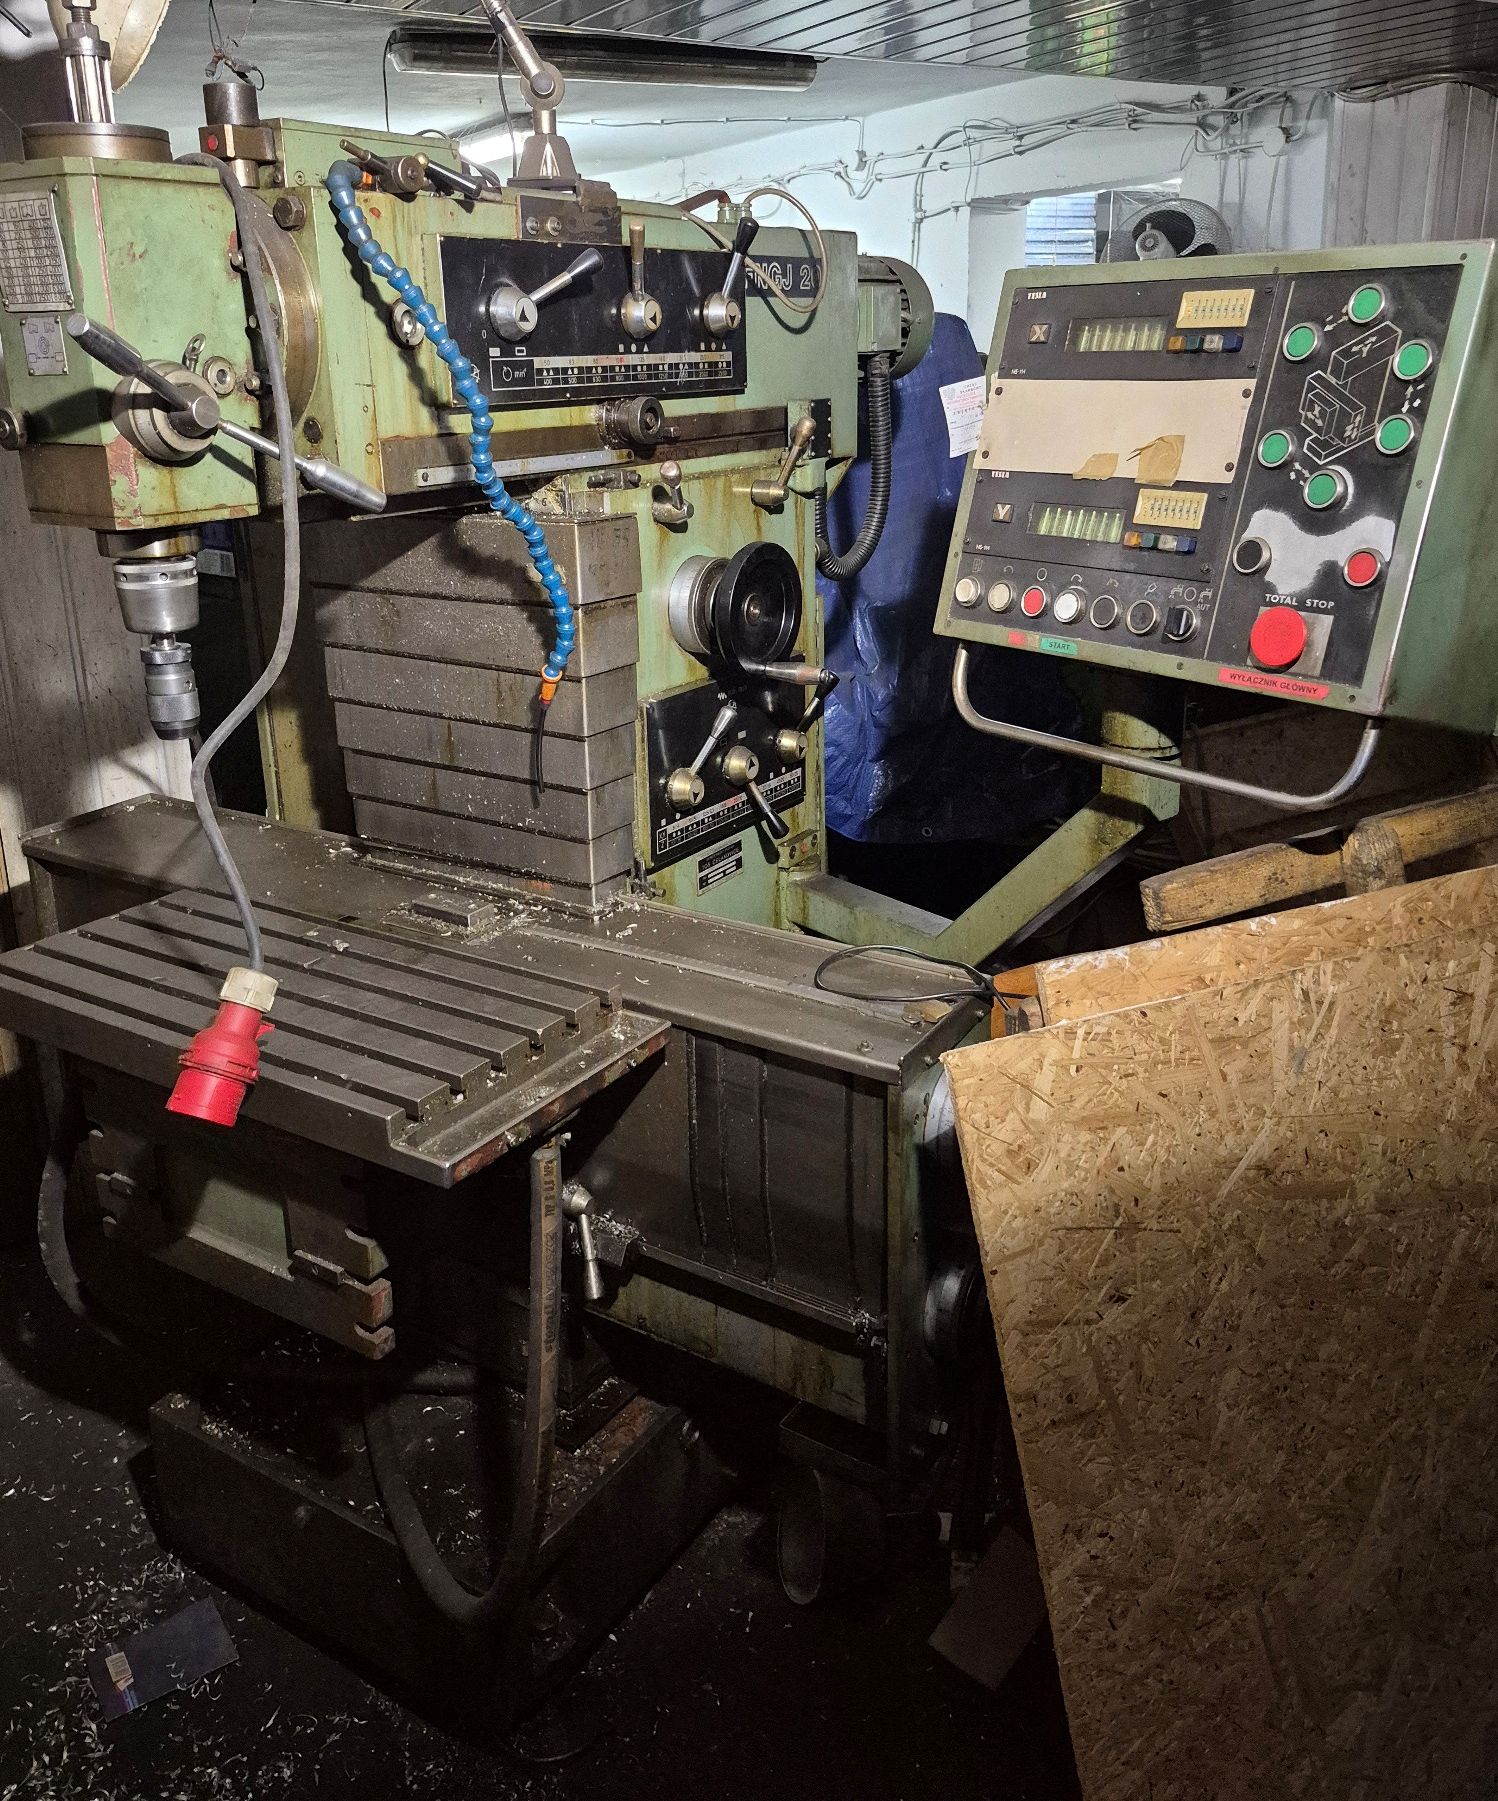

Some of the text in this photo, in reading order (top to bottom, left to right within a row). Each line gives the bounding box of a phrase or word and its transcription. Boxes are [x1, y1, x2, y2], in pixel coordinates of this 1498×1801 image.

[1027, 291, 1047, 300] TESLA
[1031, 324, 1047, 342] X
[996, 504, 1011, 520] Y
[1265, 593, 1335, 609] TOTAL STOP
[1048, 641, 1071, 651] START
[1229, 672, 1318, 695] WYŁĄCZNIK GŁÓWNY
